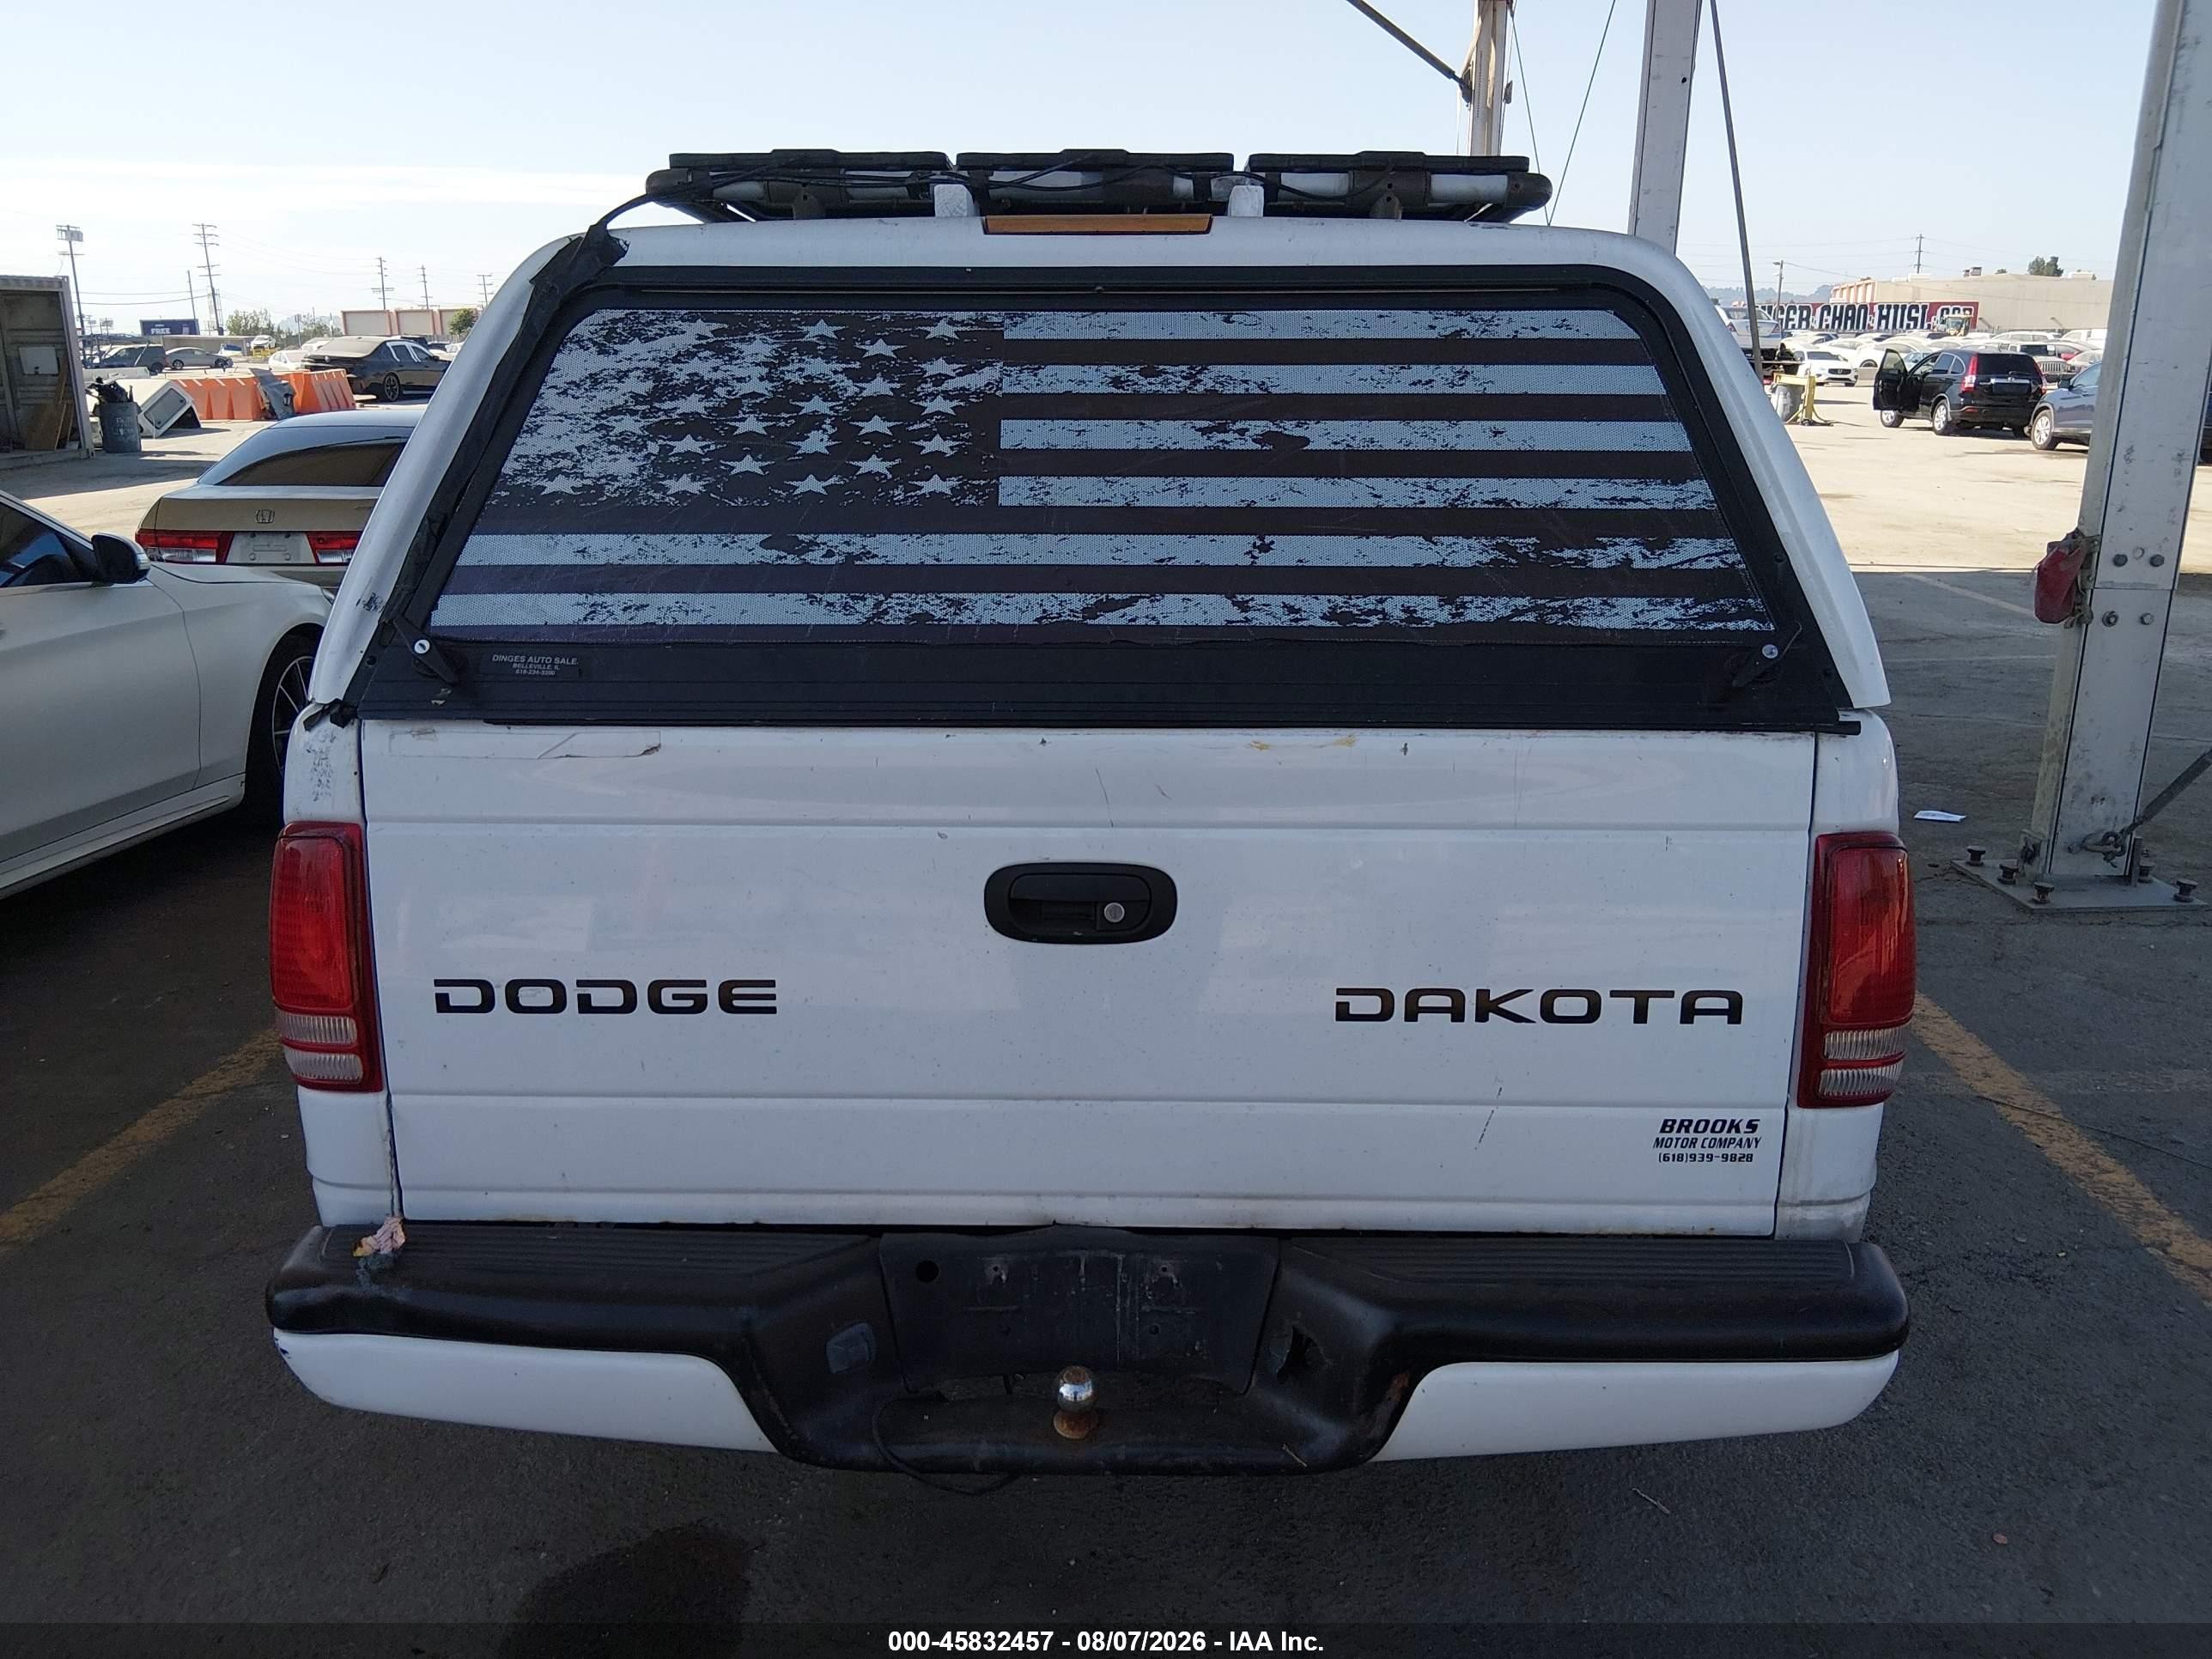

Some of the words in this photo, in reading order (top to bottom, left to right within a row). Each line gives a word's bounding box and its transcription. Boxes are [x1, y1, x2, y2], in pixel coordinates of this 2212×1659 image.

[492, 654, 526, 663] DINGES
[434, 979, 777, 1014] DODGE
[1335, 988, 1743, 1024] DAKOTA
[1659, 1119, 1760, 1134] BROOKS
[1653, 1137, 1698, 1149] MOTOR
[1700, 1137, 1762, 1149] COMPANY
[1658, 1152, 1753, 1163] (618)939-9828
